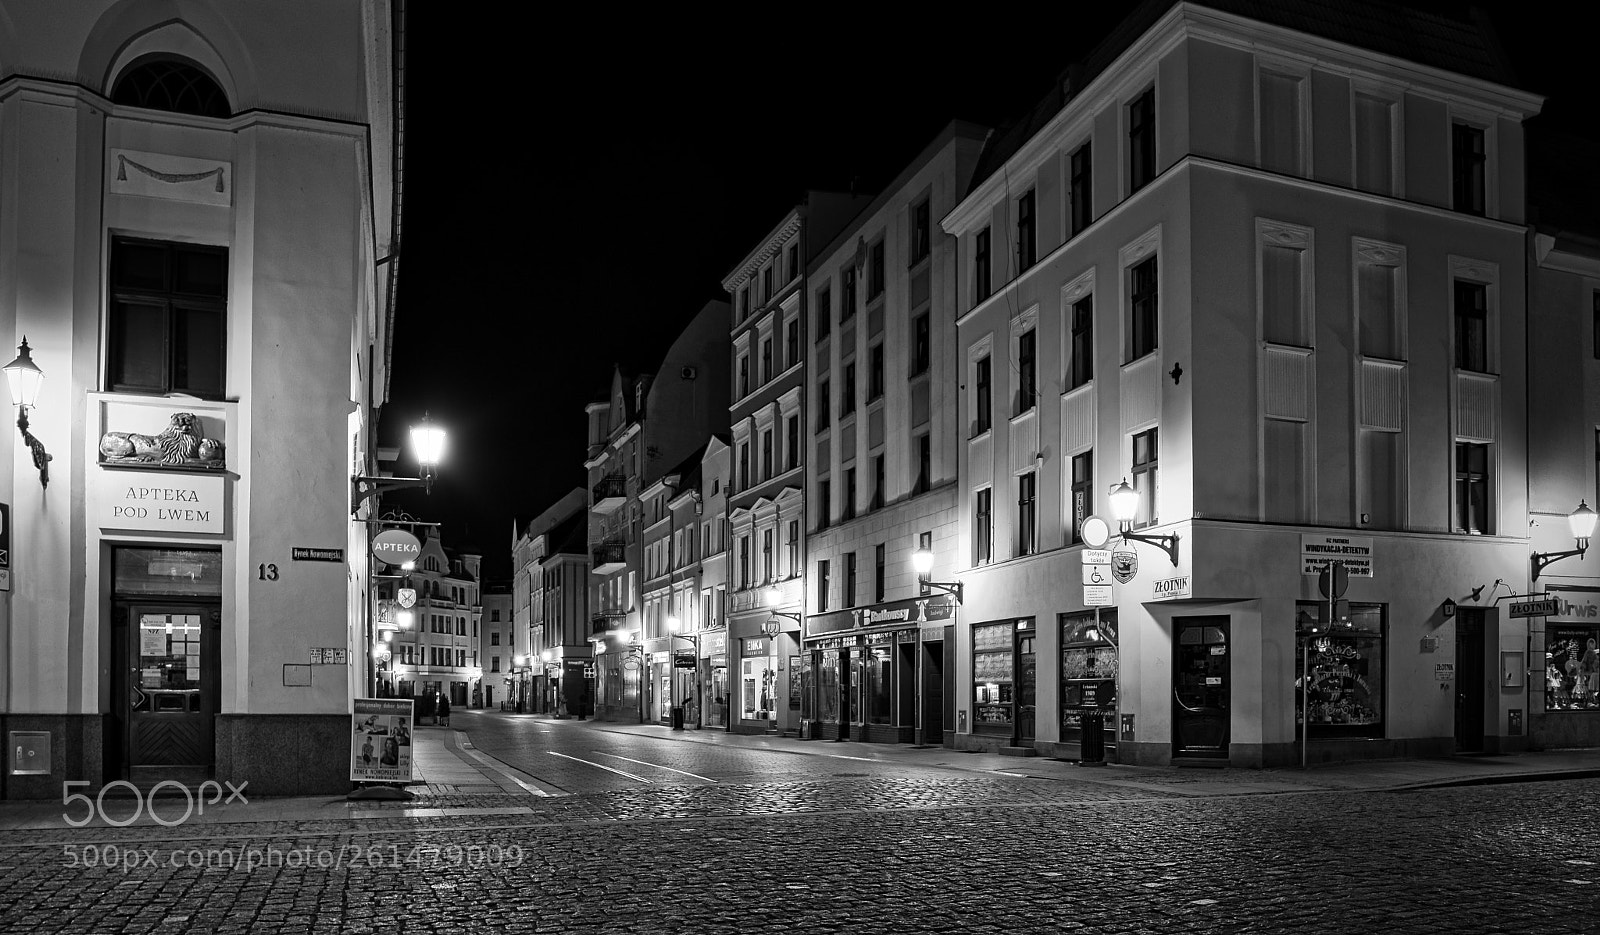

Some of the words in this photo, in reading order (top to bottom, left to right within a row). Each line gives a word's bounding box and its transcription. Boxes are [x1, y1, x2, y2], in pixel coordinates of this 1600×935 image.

[126, 487, 199, 502] APTEKA
[113, 506, 148, 518] POD
[158, 508, 210, 521] LWEM
[374, 542, 419, 552] APTEKA
[1305, 544, 1370, 554] WINDYKACJA-DETEKTYW
[258, 563, 280, 581] 13
[1154, 577, 1189, 593] ZŁOTNIK
[1511, 602, 1553, 614] ZŁOTNIK
